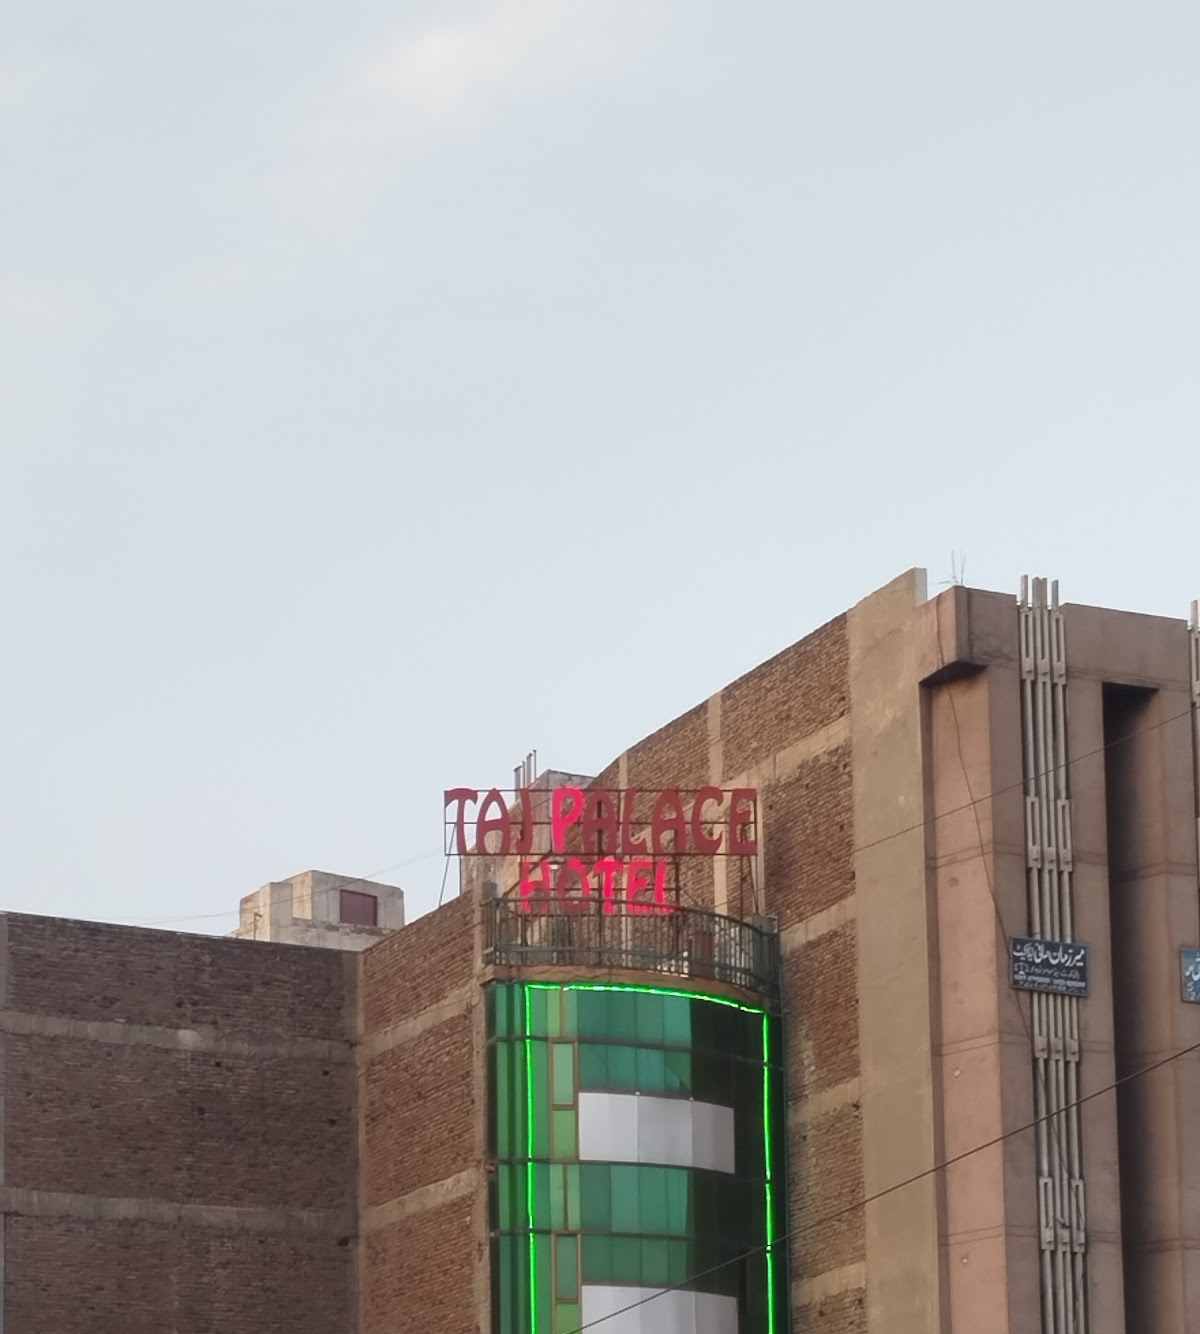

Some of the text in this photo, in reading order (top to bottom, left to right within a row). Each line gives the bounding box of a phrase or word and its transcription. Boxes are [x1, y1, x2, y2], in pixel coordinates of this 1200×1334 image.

[444, 786, 757, 855] TAJ PALACE
[519, 858, 683, 915] HOTEL
